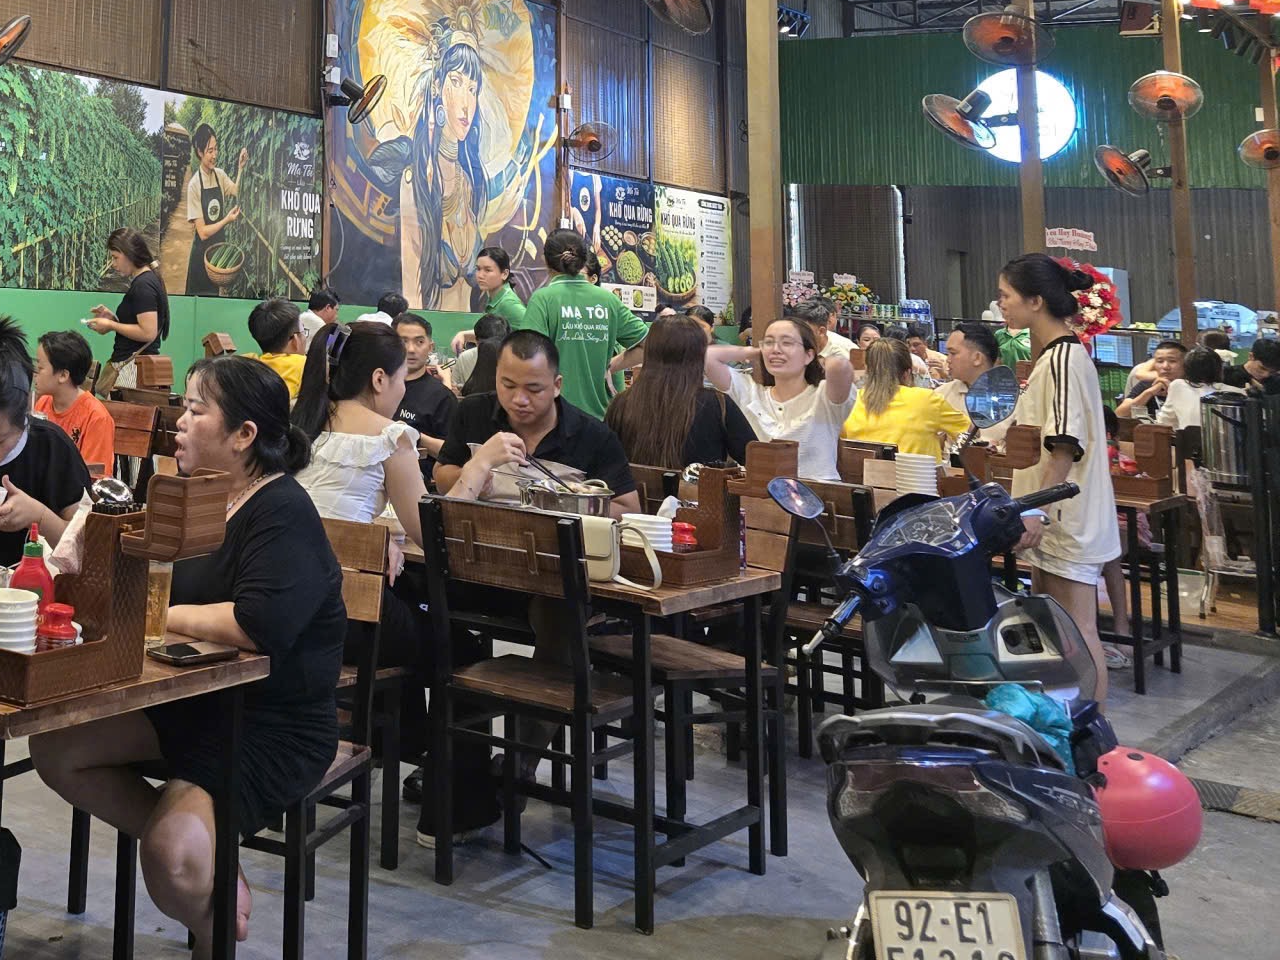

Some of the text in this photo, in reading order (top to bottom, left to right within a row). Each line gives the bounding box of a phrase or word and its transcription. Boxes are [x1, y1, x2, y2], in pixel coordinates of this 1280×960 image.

[302, 193, 321, 216] QUA
[623, 204, 636, 222] QUA
[286, 213, 314, 239] RỪNG
[561, 303, 609, 320] MẠ TÔI
[400, 408, 416, 421] Nov.
[894, 900, 994, 945] 92-E1
